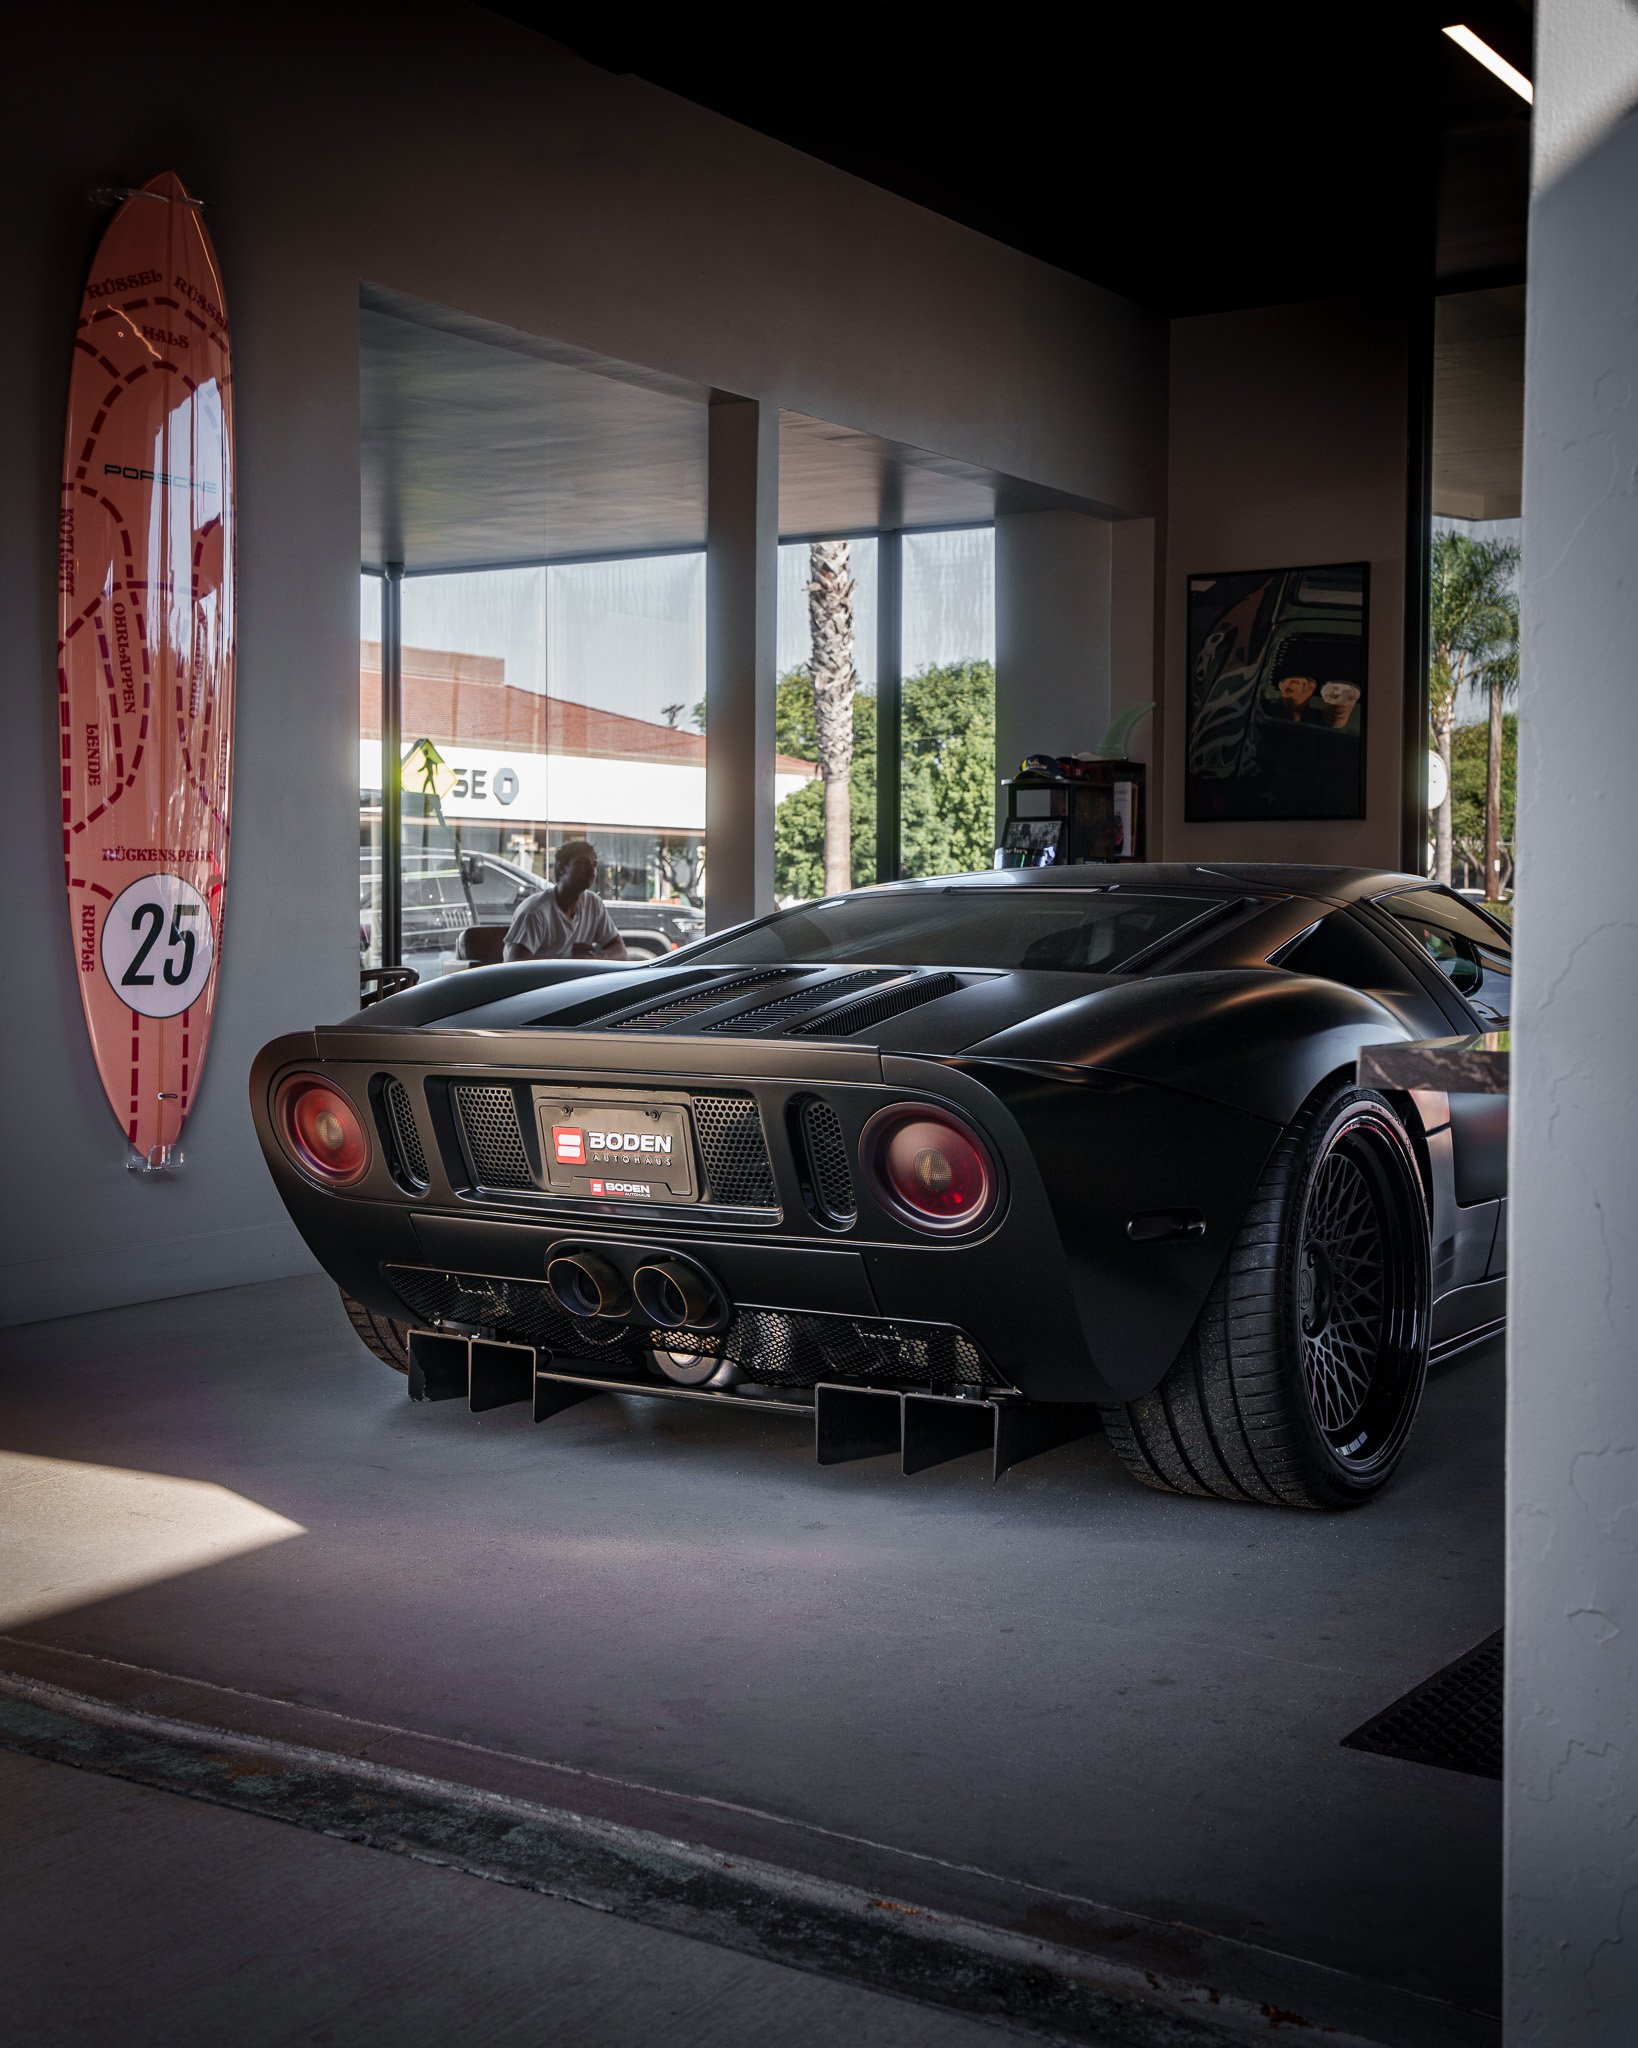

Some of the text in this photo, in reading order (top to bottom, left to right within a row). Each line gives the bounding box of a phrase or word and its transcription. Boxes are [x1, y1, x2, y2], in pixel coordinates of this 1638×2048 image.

[86, 269, 162, 299] RÜSSEL
[142, 325, 189, 349] HALS
[104, 463, 216, 494] PORSCHE
[59, 507, 75, 597] KOTLETT
[112, 602, 136, 714] OHRLAPPEN
[85, 723, 101, 786] LENDE
[81, 903, 95, 973] RIPPLE
[121, 903, 200, 986] 25
[588, 1130, 672, 1153] BODEN
[593, 1154, 672, 1166] AUTOHAUS
[605, 1182, 650, 1193] BODEN
